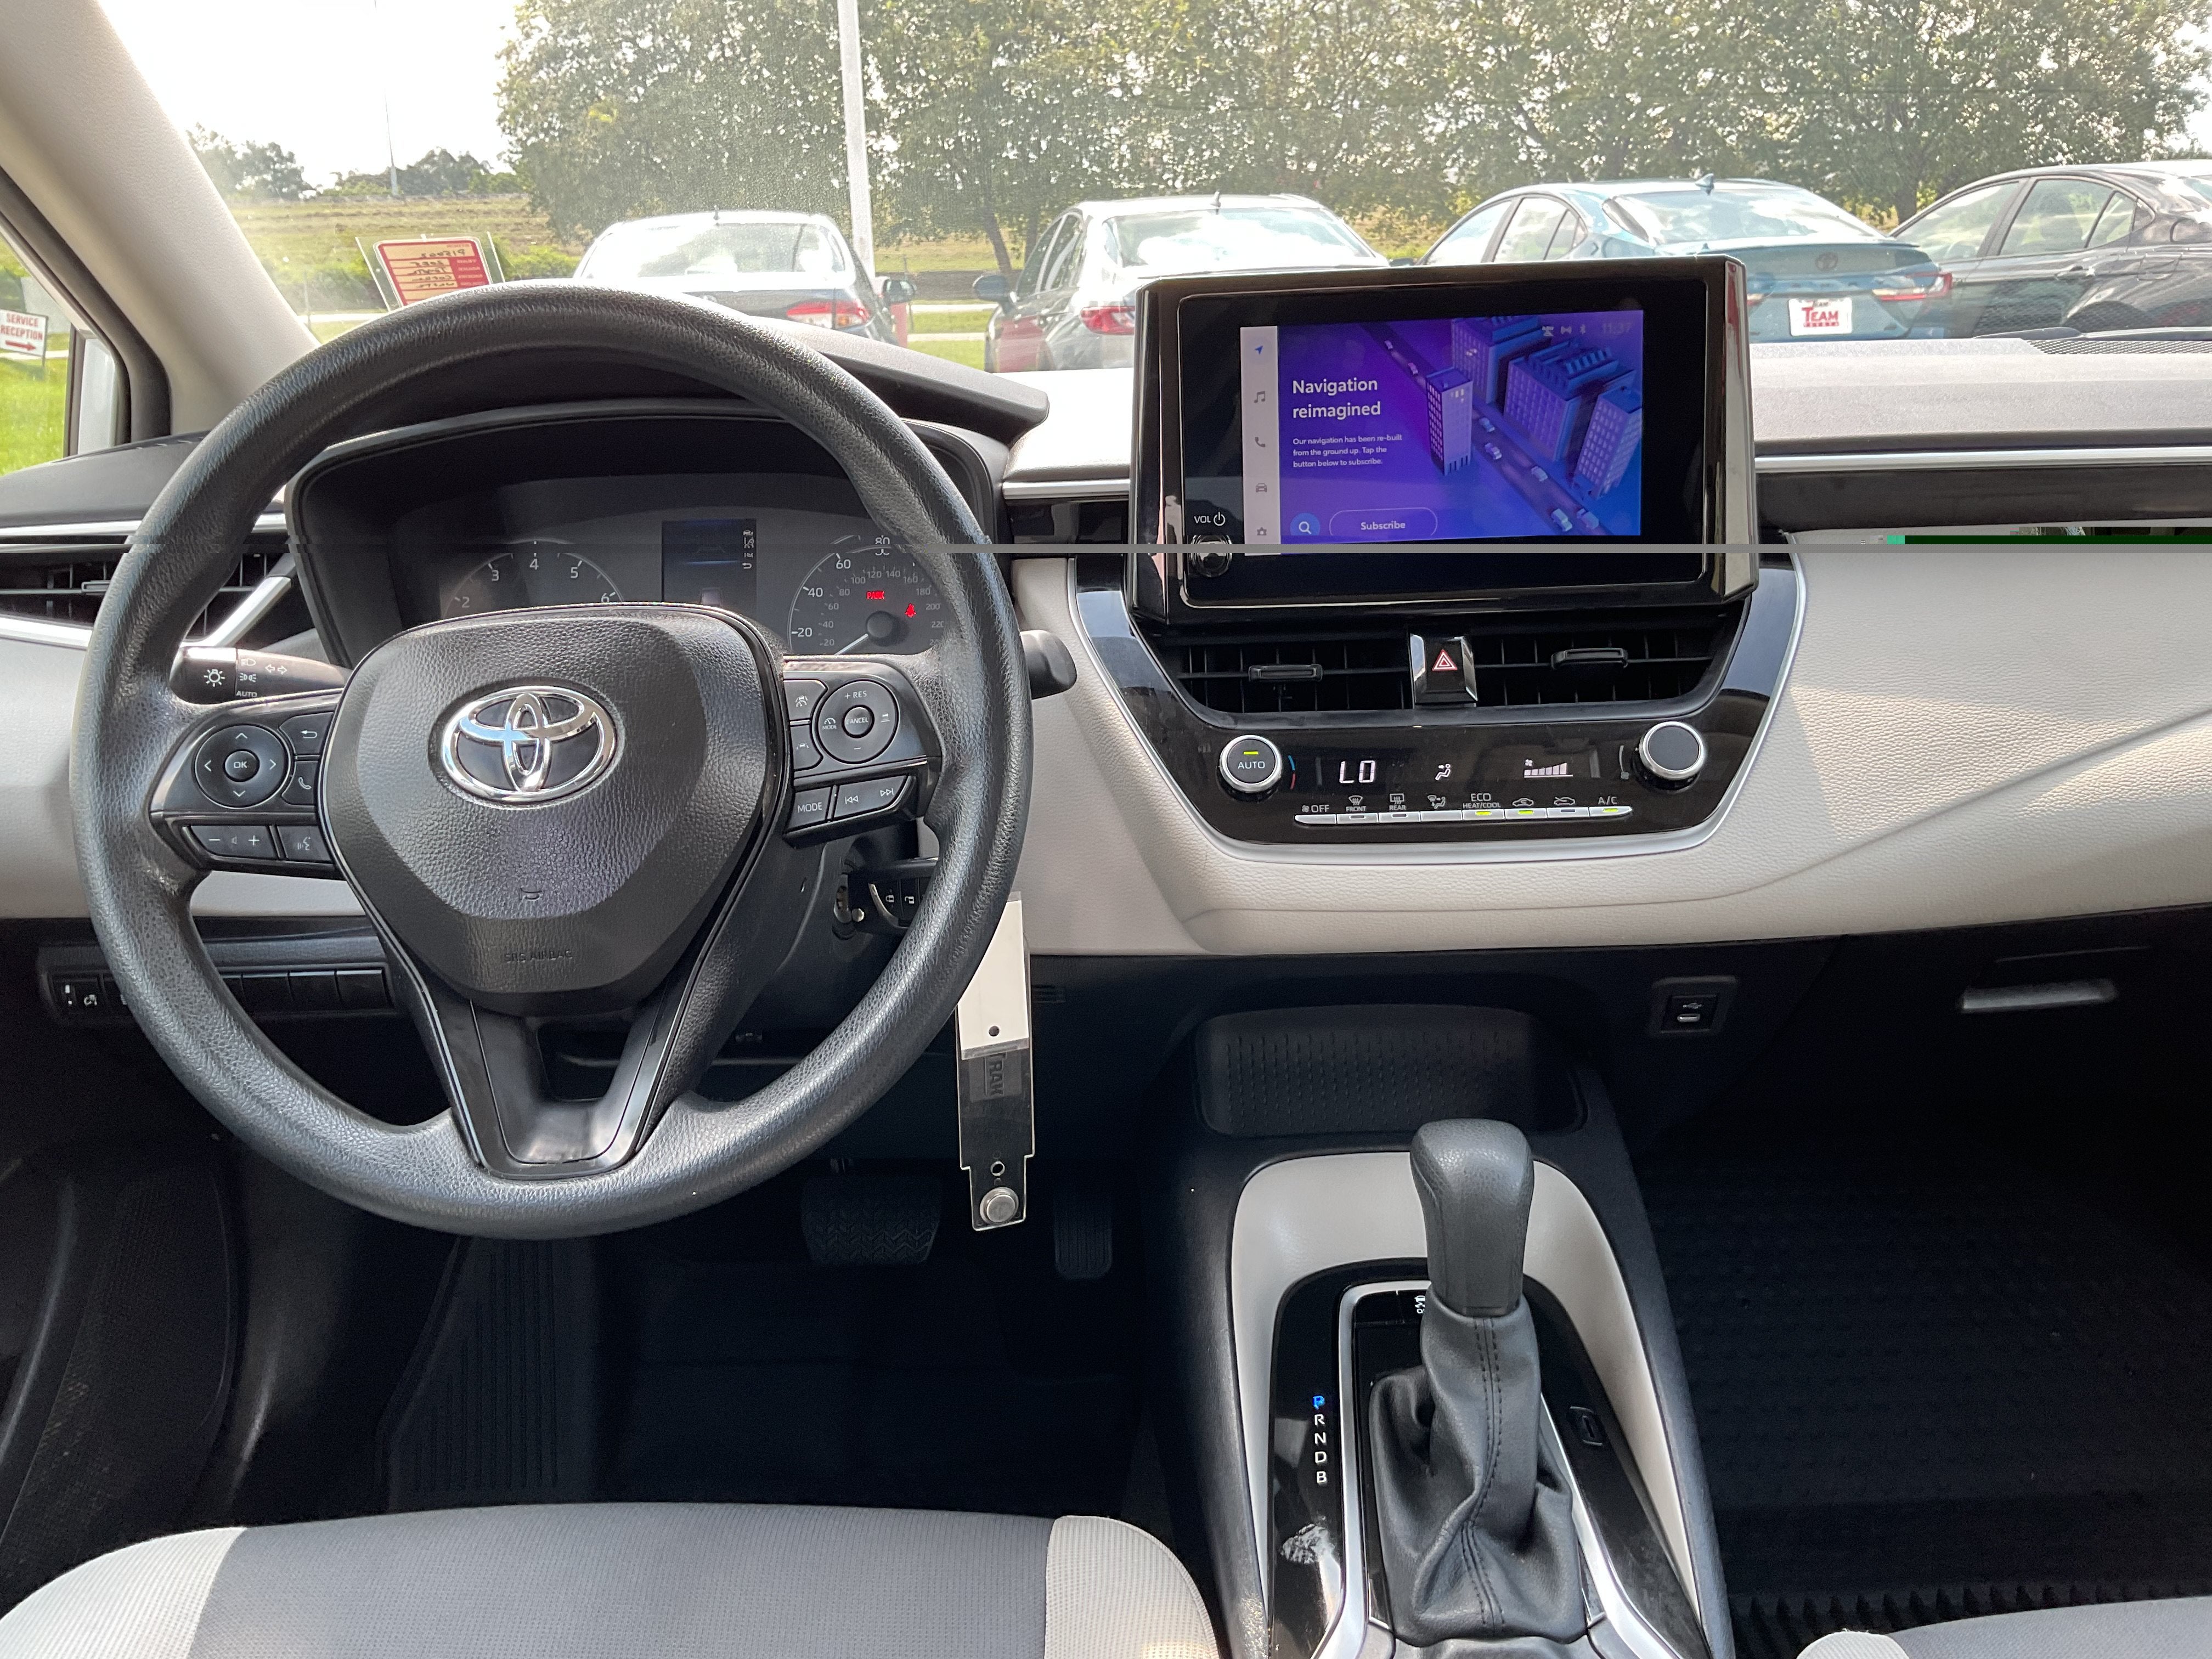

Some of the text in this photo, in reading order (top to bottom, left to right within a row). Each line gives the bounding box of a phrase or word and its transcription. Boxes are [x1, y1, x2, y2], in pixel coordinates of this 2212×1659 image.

[1802, 307, 1839, 321] TEAM
[7, 313, 38, 327] SERVICE
[0, 325, 43, 340] RECEPTION
[1293, 377, 1378, 396] Navigation
[1293, 401, 1381, 420] reimagined
[1308, 436, 1344, 445] navigation
[1323, 448, 1348, 456] ground
[1194, 515, 1211, 523] VOL
[1361, 520, 1406, 530] Subscribe
[530, 558, 539, 570] 4
[836, 560, 851, 569] 60
[492, 570, 499, 581] 3
[570, 567, 579, 578] 5
[601, 592, 610, 602] 6
[808, 588, 823, 597] 40
[462, 597, 470, 608] 2
[797, 627, 812, 636] 20
[853, 690, 867, 698] RES
[846, 716, 868, 725] CANCEL
[233, 760, 247, 769] OK
[1238, 761, 1265, 769] AUTO
[1339, 760, 1376, 783] LO
[1470, 793, 1491, 802] ECO
[1598, 796, 1618, 805] A/C
[797, 802, 822, 813] MODE
[1311, 804, 1330, 812] OFF
[1313, 1395, 1325, 1409] P
[1314, 1414, 1325, 1425] R
[1314, 1432, 1326, 1444] N
[1314, 1451, 1327, 1463] D
[1317, 1471, 1327, 1483] B
